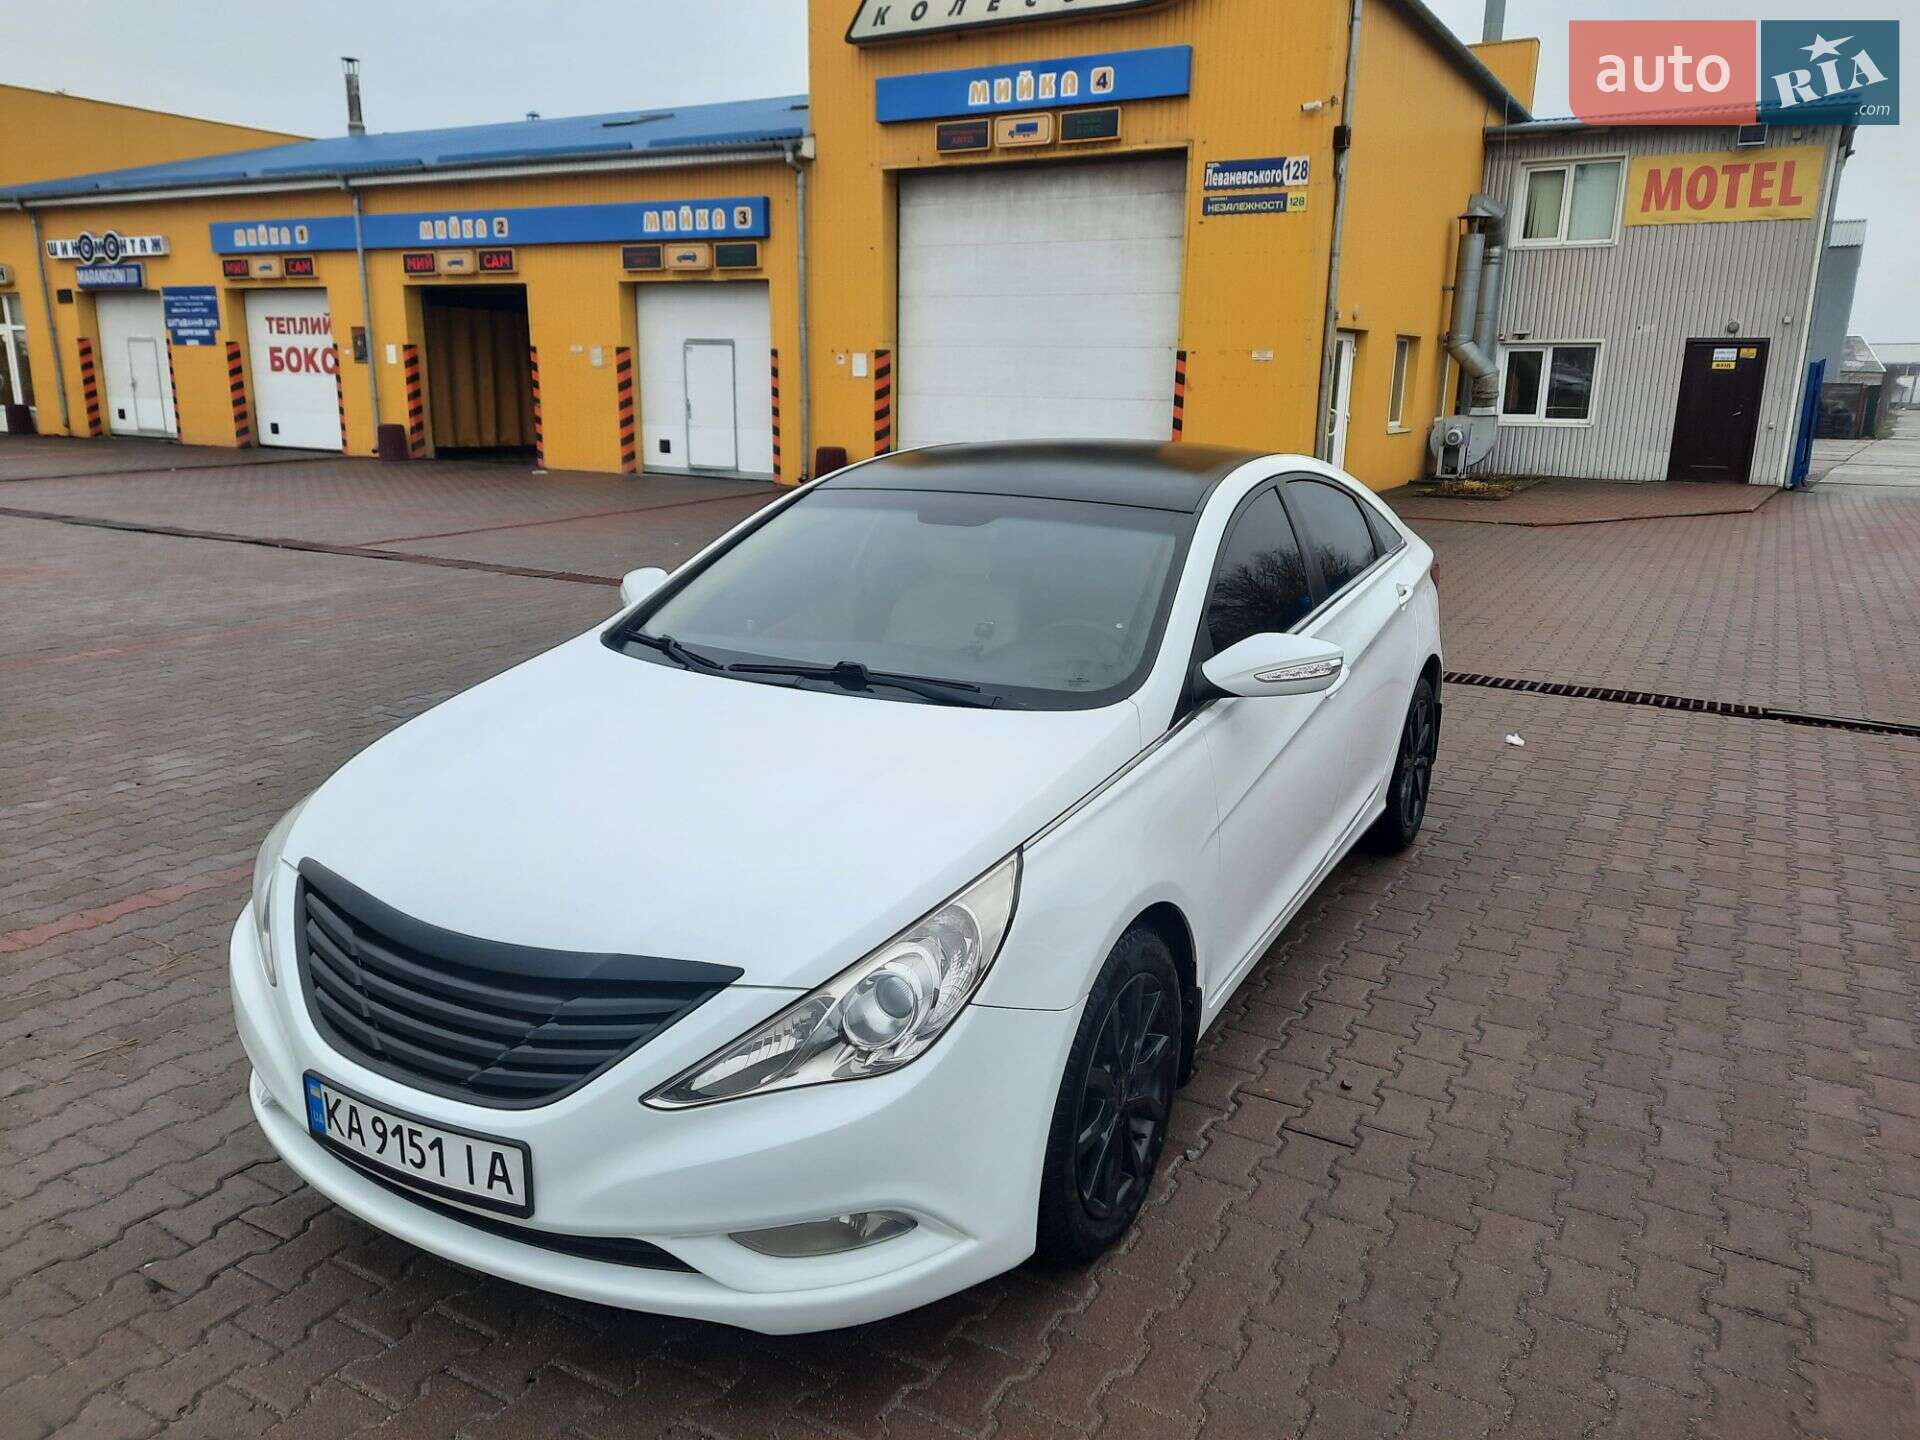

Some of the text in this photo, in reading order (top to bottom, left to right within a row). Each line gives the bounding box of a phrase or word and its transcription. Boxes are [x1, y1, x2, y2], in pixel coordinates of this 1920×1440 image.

[968, 70, 1078, 106] МИЙКА
[1204, 160, 1308, 187] Леваневського 128
[1640, 160, 1803, 212] MOTEL
[1207, 196, 1305, 213] НЕЗАЛЕЖНОСТІ 128
[643, 206, 726, 232] МИЙКА
[47, 234, 162, 262] ШИНОМОНТАЖ
[483, 254, 511, 268] САМ
[265, 312, 331, 335] ТЕПЛИЙ
[324, 1091, 514, 1196] KA 9151 IA
